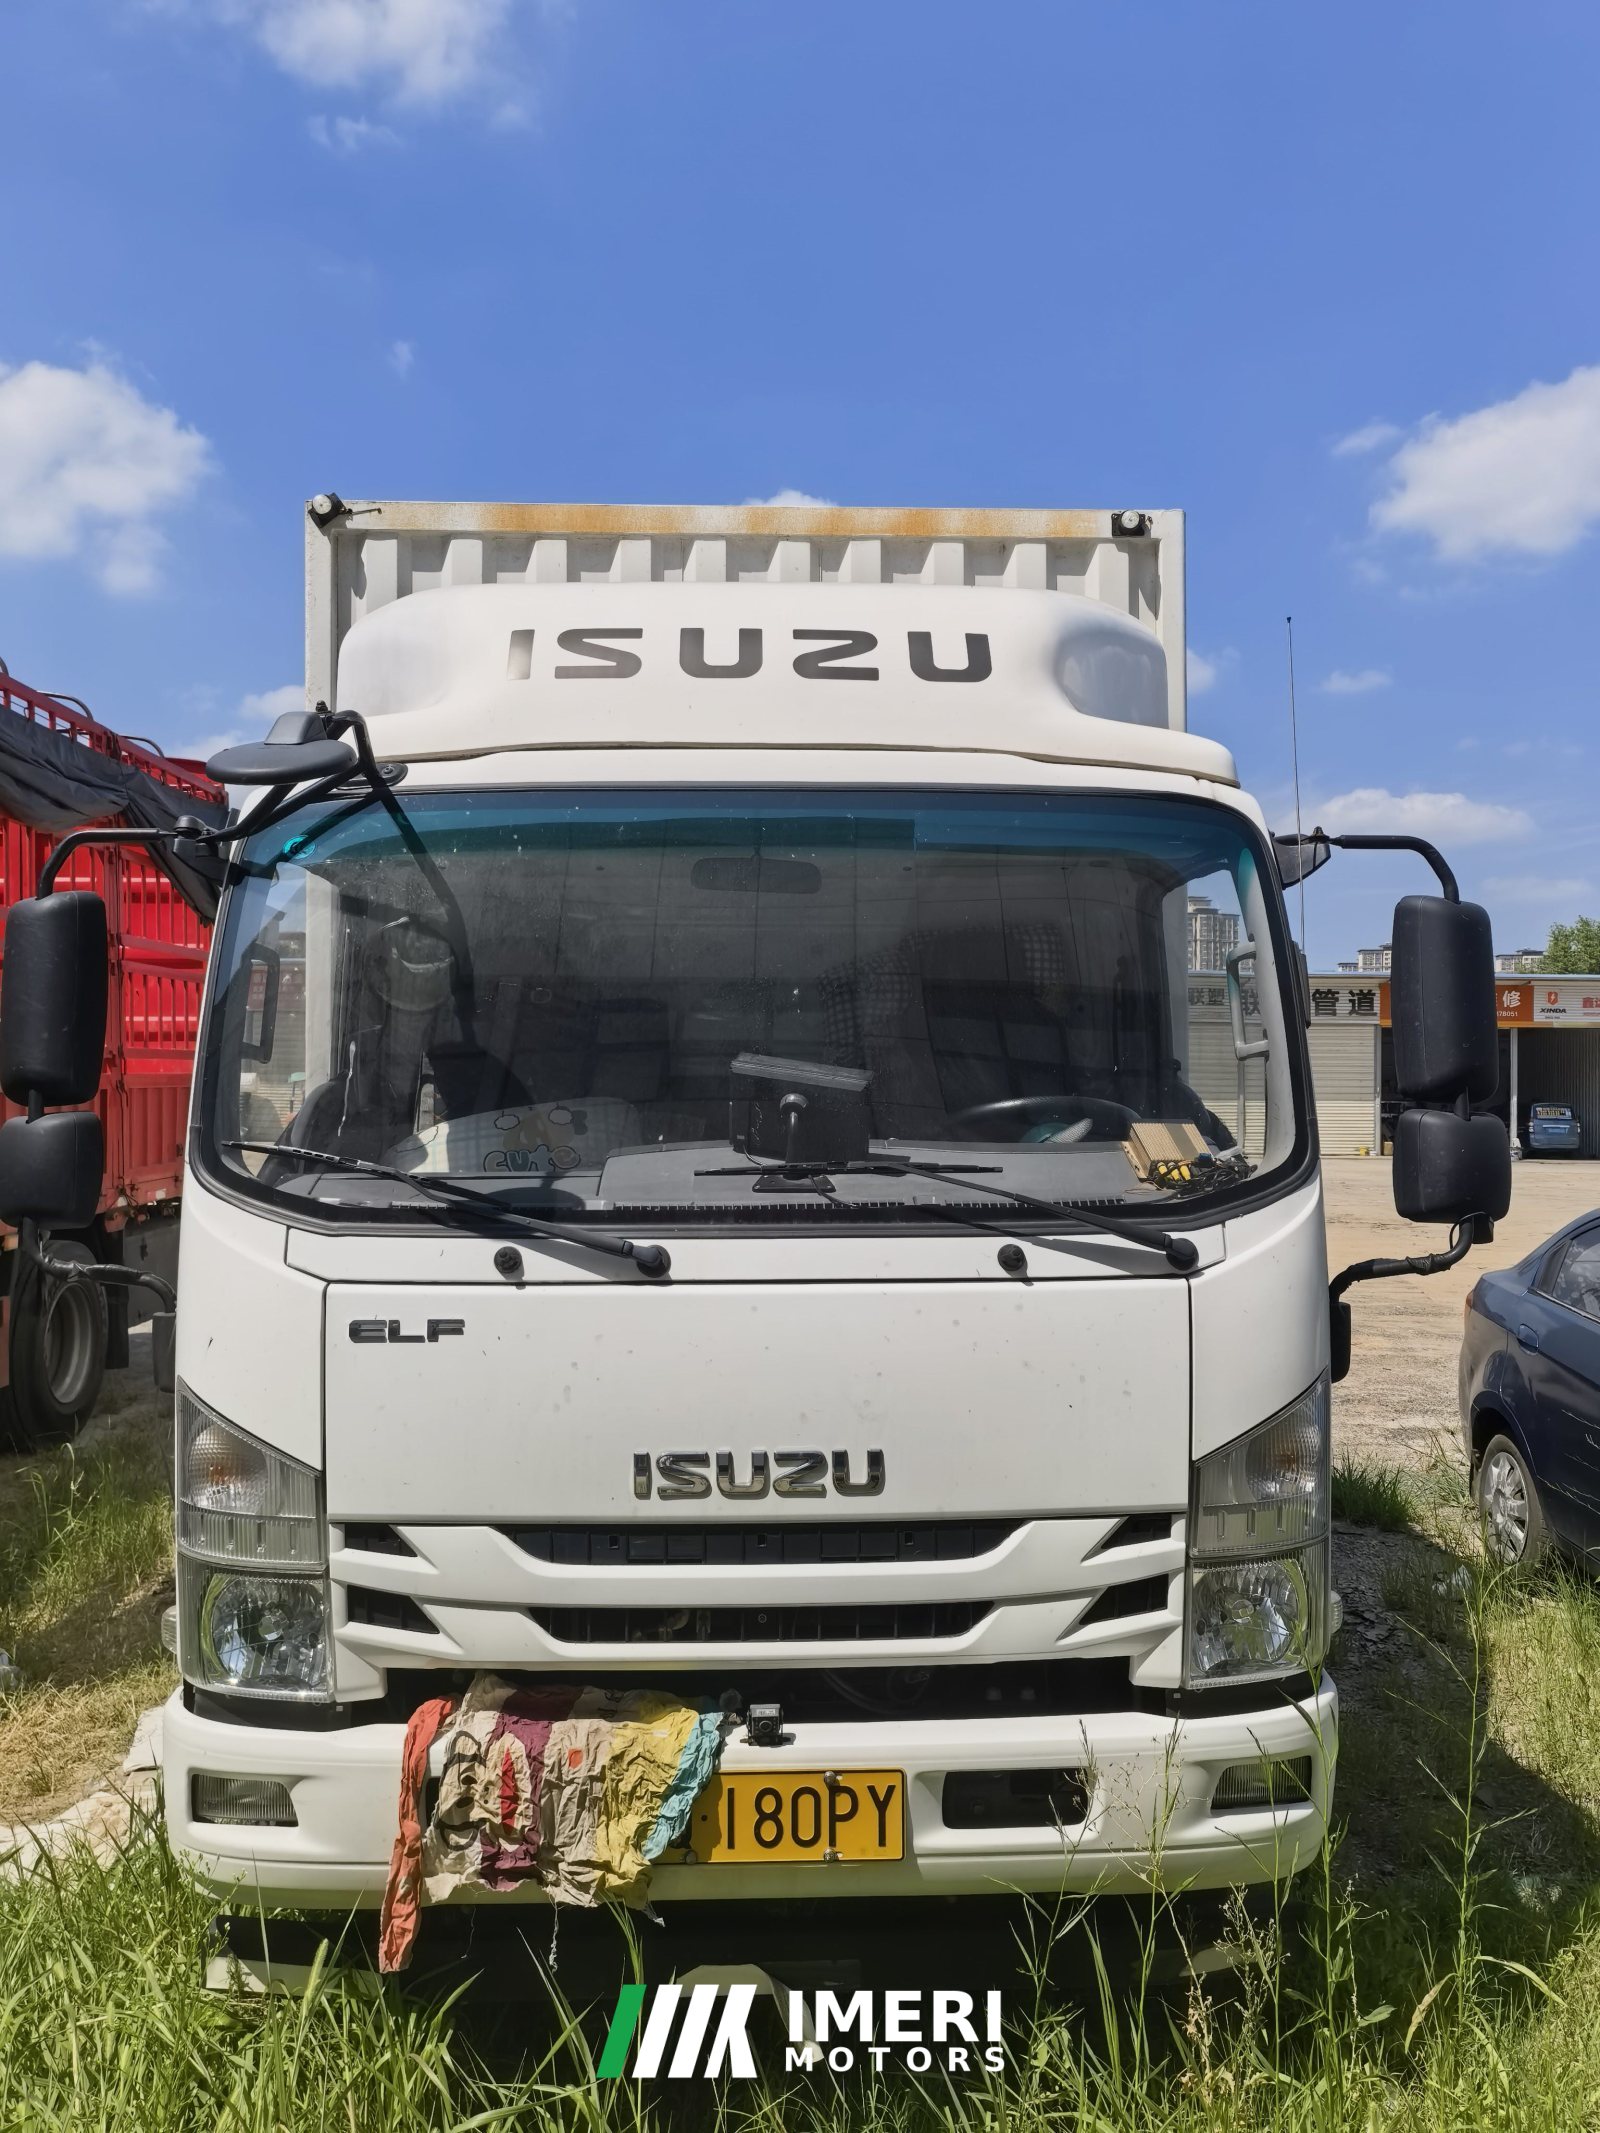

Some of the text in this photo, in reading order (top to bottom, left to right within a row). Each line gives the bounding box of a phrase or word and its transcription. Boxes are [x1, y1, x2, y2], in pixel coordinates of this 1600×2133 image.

[507, 626, 993, 683] ISUZU
[1311, 988, 1378, 1017] 管道
[1496, 990, 1521, 1008] 修
[348, 1318, 466, 1344] ELF
[633, 1448, 886, 1500] ISUZU
